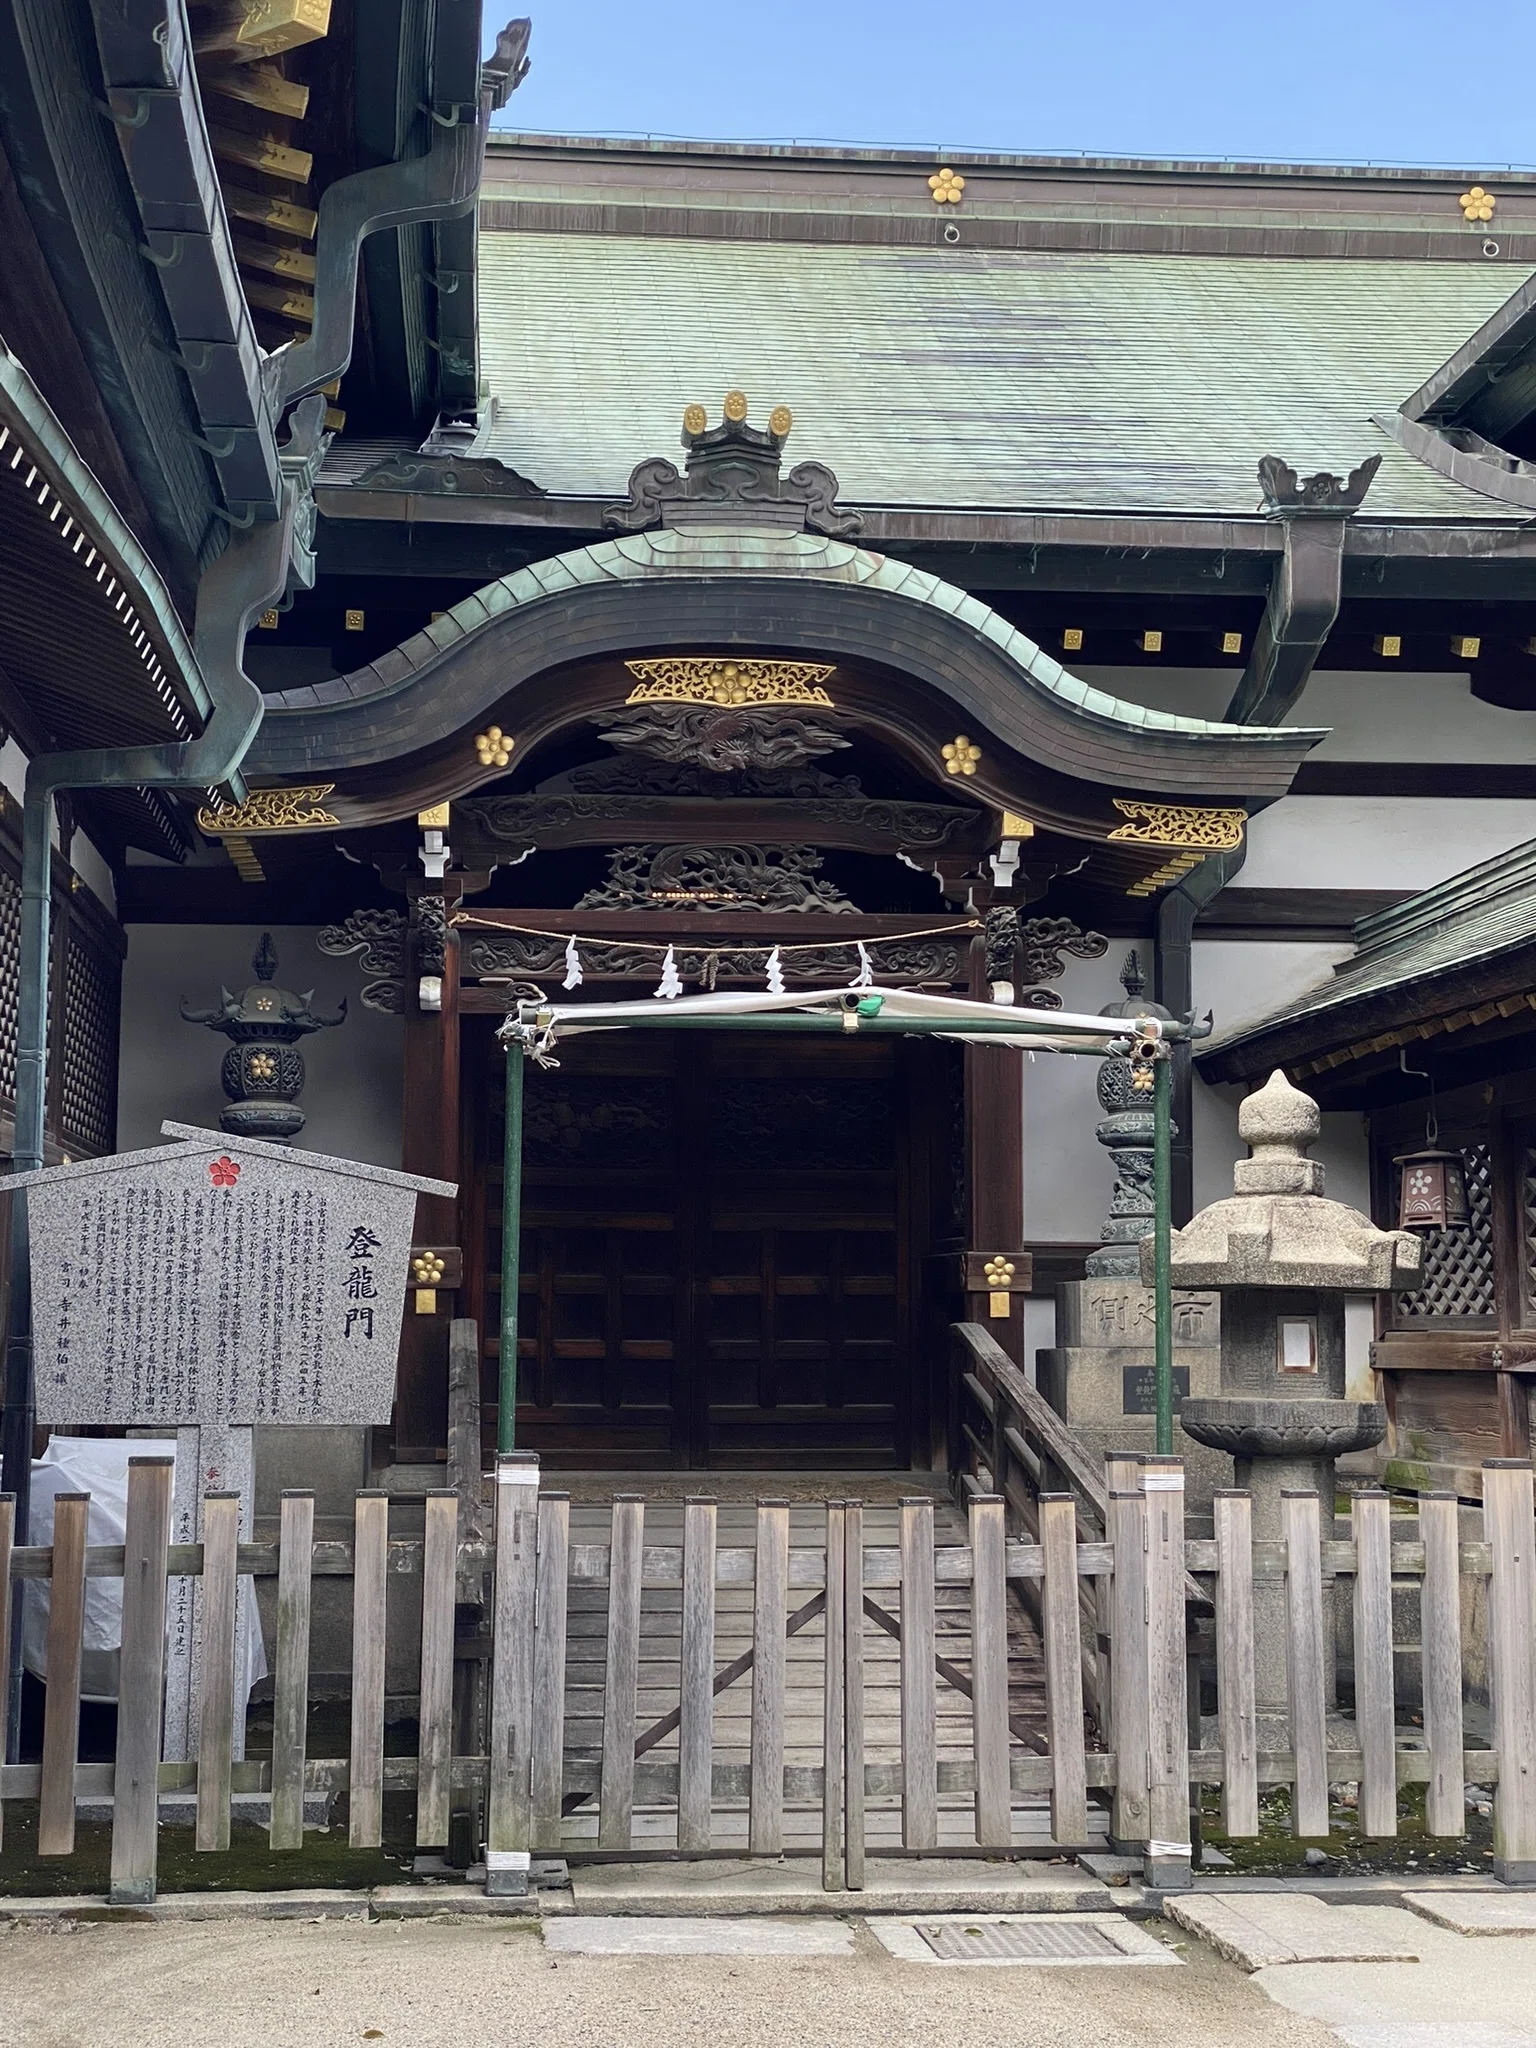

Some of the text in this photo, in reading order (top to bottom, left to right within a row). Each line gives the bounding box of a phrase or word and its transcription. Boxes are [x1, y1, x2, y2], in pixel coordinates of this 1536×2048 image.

[208, 1189, 218, 1235] なりました
[342, 1225, 382, 1340] 登龍門
